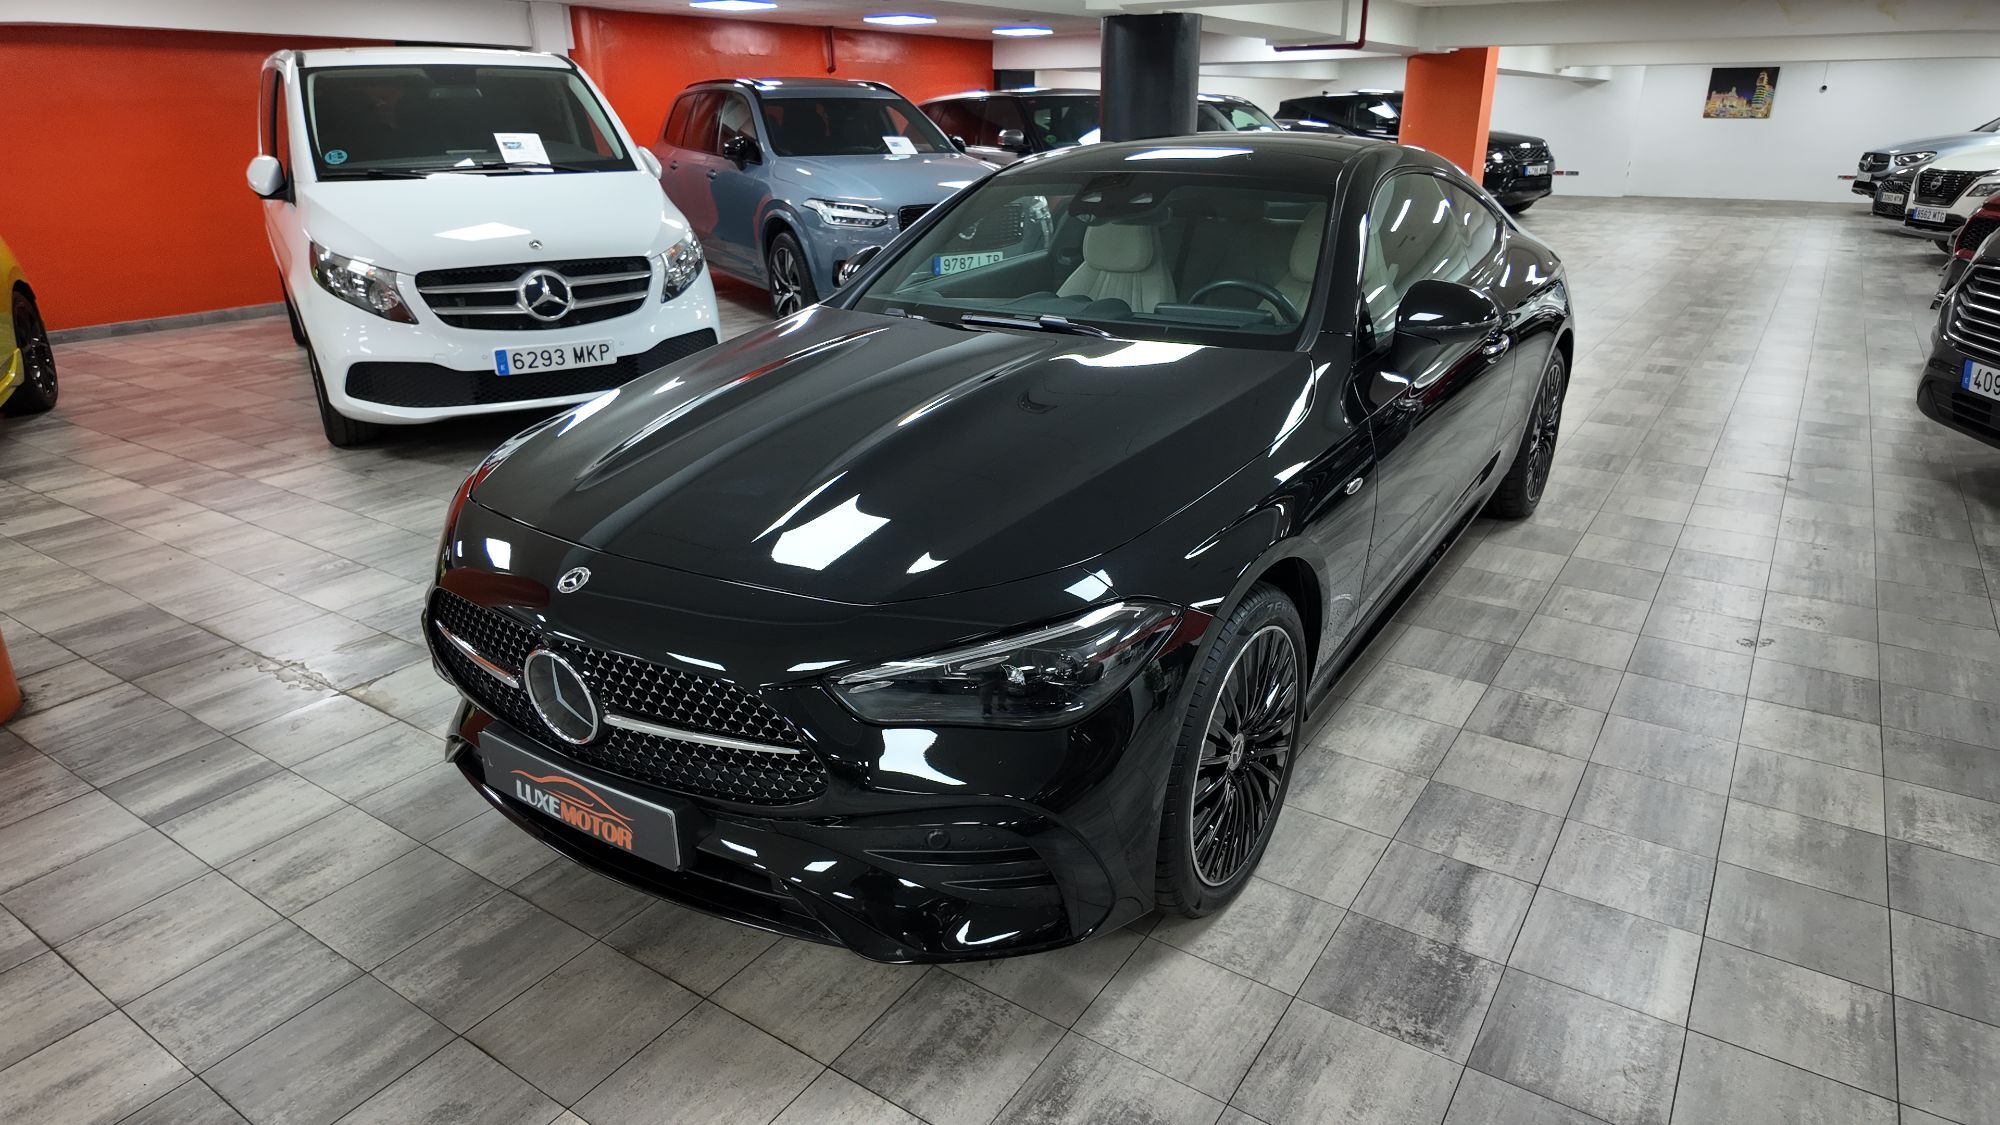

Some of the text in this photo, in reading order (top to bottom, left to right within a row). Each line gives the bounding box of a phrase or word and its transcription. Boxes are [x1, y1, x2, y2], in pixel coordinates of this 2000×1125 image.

[943, 256, 974, 271] 9787
[512, 343, 610, 370] 6293 MKP
[515, 779, 633, 850] LUXEMOTOR
